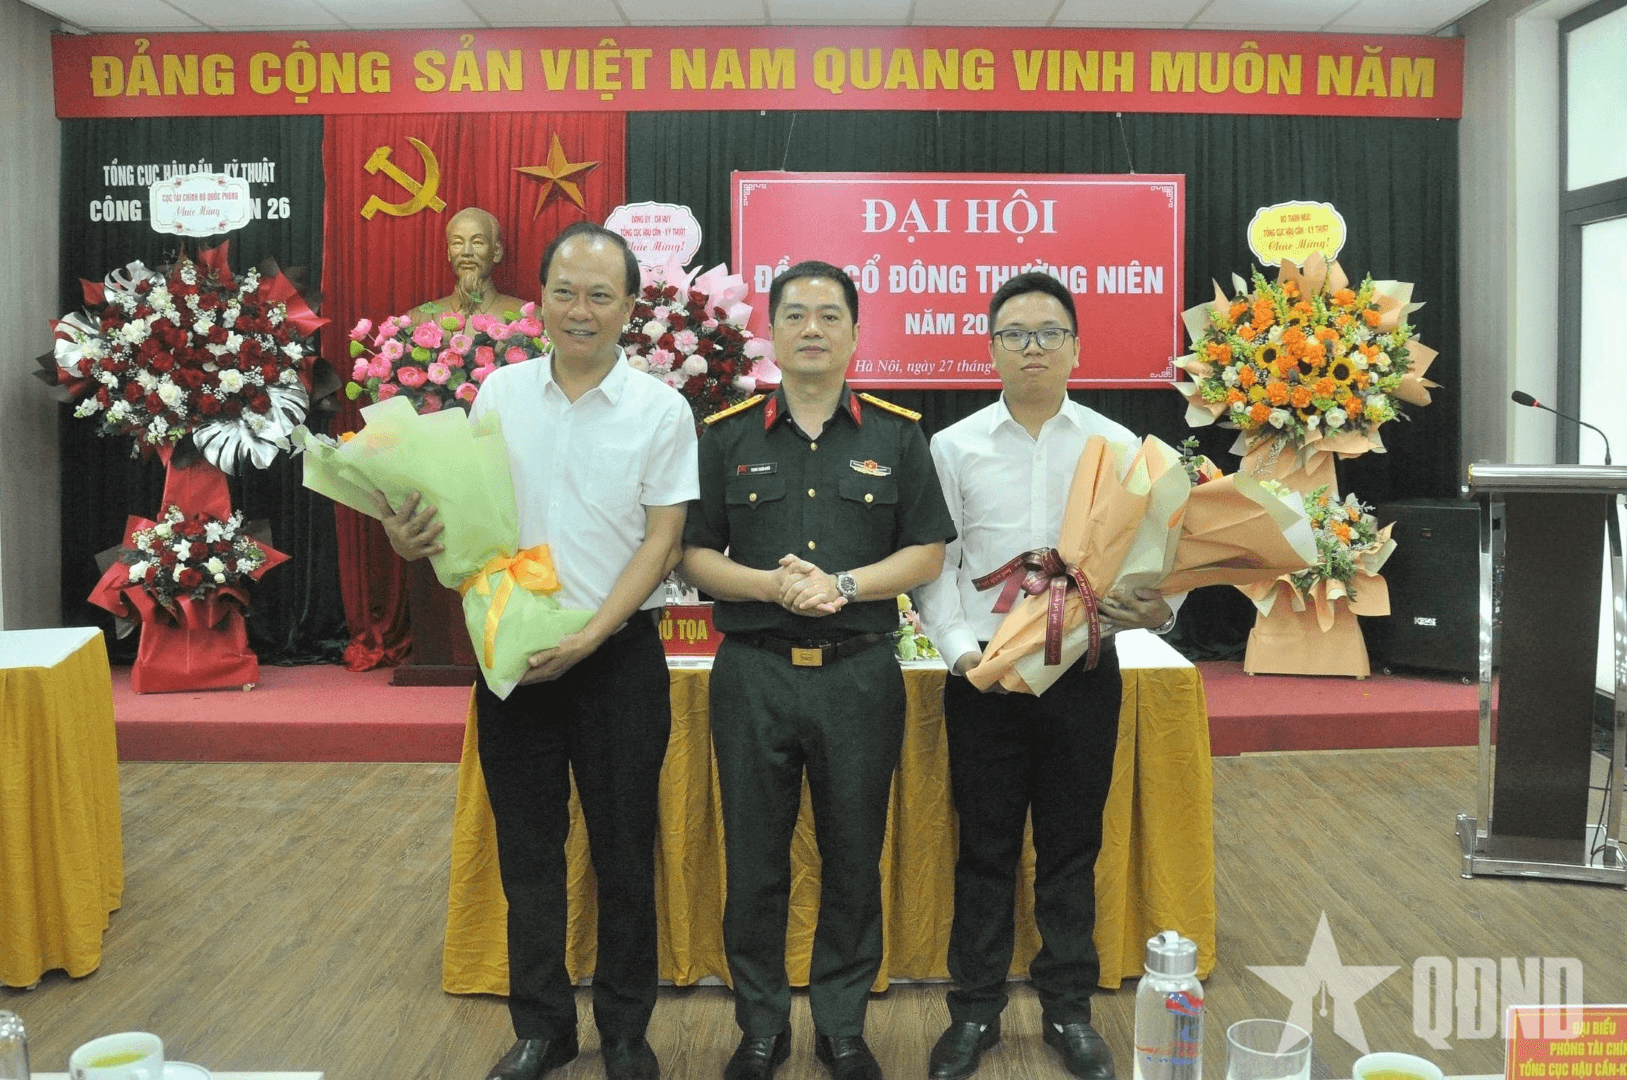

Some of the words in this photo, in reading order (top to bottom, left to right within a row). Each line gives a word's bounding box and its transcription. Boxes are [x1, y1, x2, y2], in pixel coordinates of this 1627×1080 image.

[89, 38, 235, 97] ĐẢNG
[249, 40, 392, 103] CỘNG
[412, 33, 525, 94] SẢN
[540, 37, 654, 102] VIỆT
[669, 45, 797, 92] NAM
[812, 46, 995, 94] QUANG
[1011, 49, 1135, 94] VINH
[1149, 41, 1303, 96] MUÔN
[1317, 45, 1436, 98] NĂM
[103, 158, 134, 186] TỔNG
[137, 165, 159, 189] CỤC
[241, 157, 276, 187] THUẬT
[90, 195, 142, 222] CÔNG
[267, 196, 291, 219] 26
[861, 198, 951, 243] ĐẠI
[964, 188, 1058, 244] HỘI
[630, 241, 648, 251] húc
[889, 259, 967, 294] ĐÔNG
[1097, 259, 1164, 294] NIÊN
[905, 308, 956, 335] NĂM
[962, 313, 989, 335] 20
[854, 359, 873, 373] Hà
[877, 359, 903, 375] Nội,
[906, 359, 936, 375] ngày
[939, 360, 953, 373] 27
[957, 359, 992, 375] tháng
[677, 619, 709, 645] TỌA
[1549, 1039, 1585, 1056] PHÒNG
[1587, 1039, 1604, 1056] TÀI
[1605, 1040, 1627, 1056] CHÍ
[1519, 1058, 1546, 1077] TỔNG
[1548, 1062, 1569, 1079] CỤC
